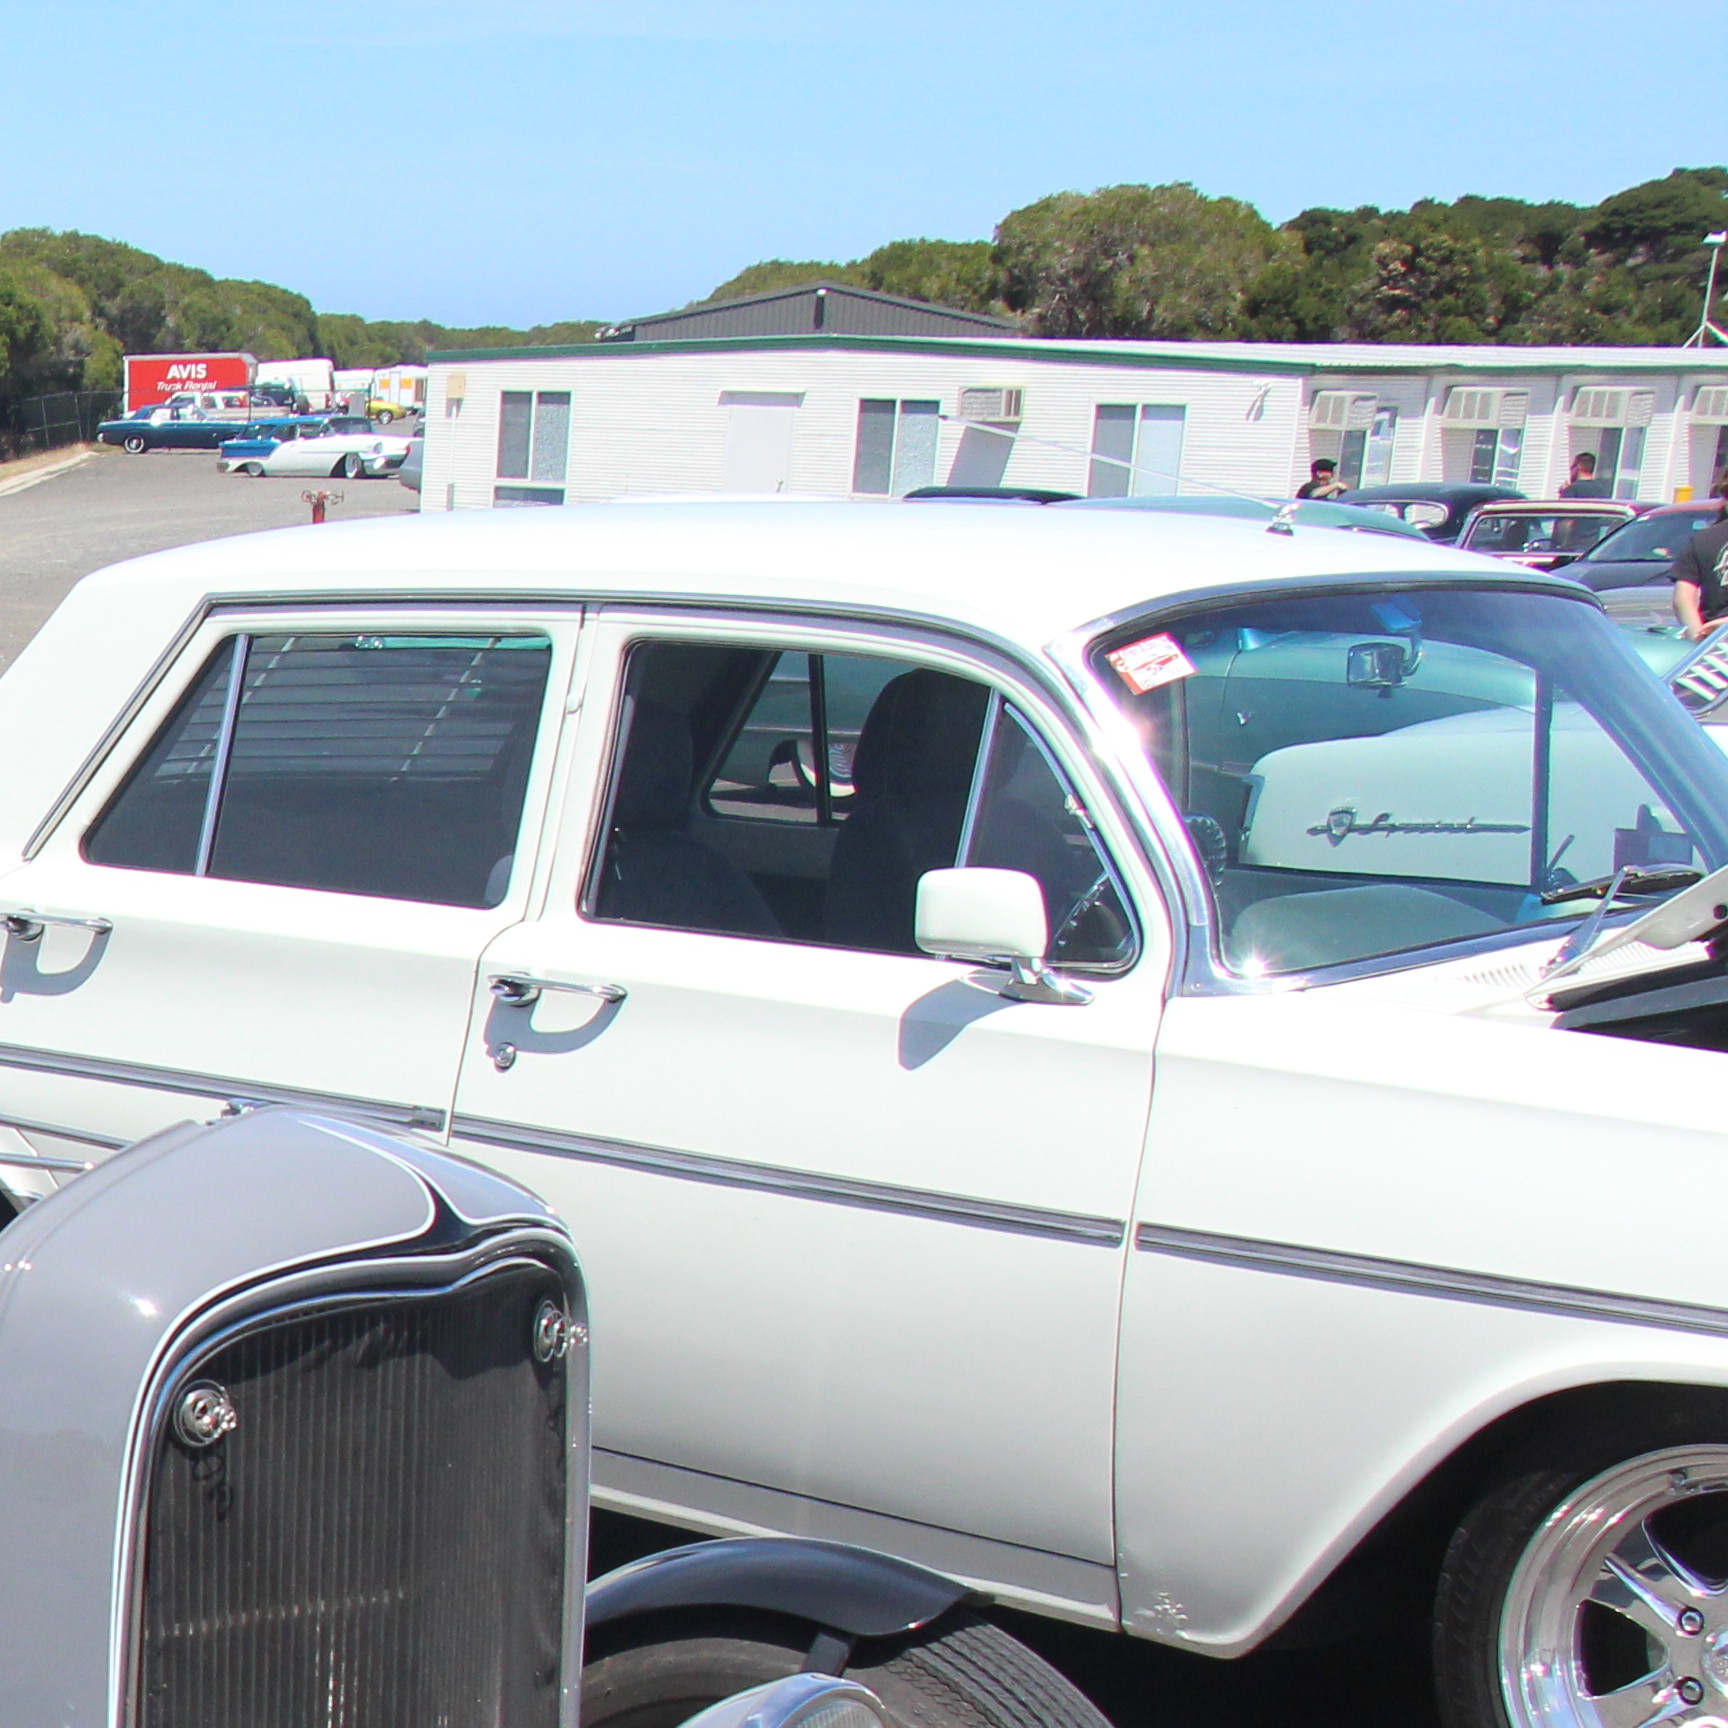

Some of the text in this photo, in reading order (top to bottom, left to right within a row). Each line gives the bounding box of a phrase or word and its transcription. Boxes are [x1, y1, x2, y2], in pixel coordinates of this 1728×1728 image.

[166, 363, 207, 379] AVIS
[156, 380, 218, 391] Truck Rental
